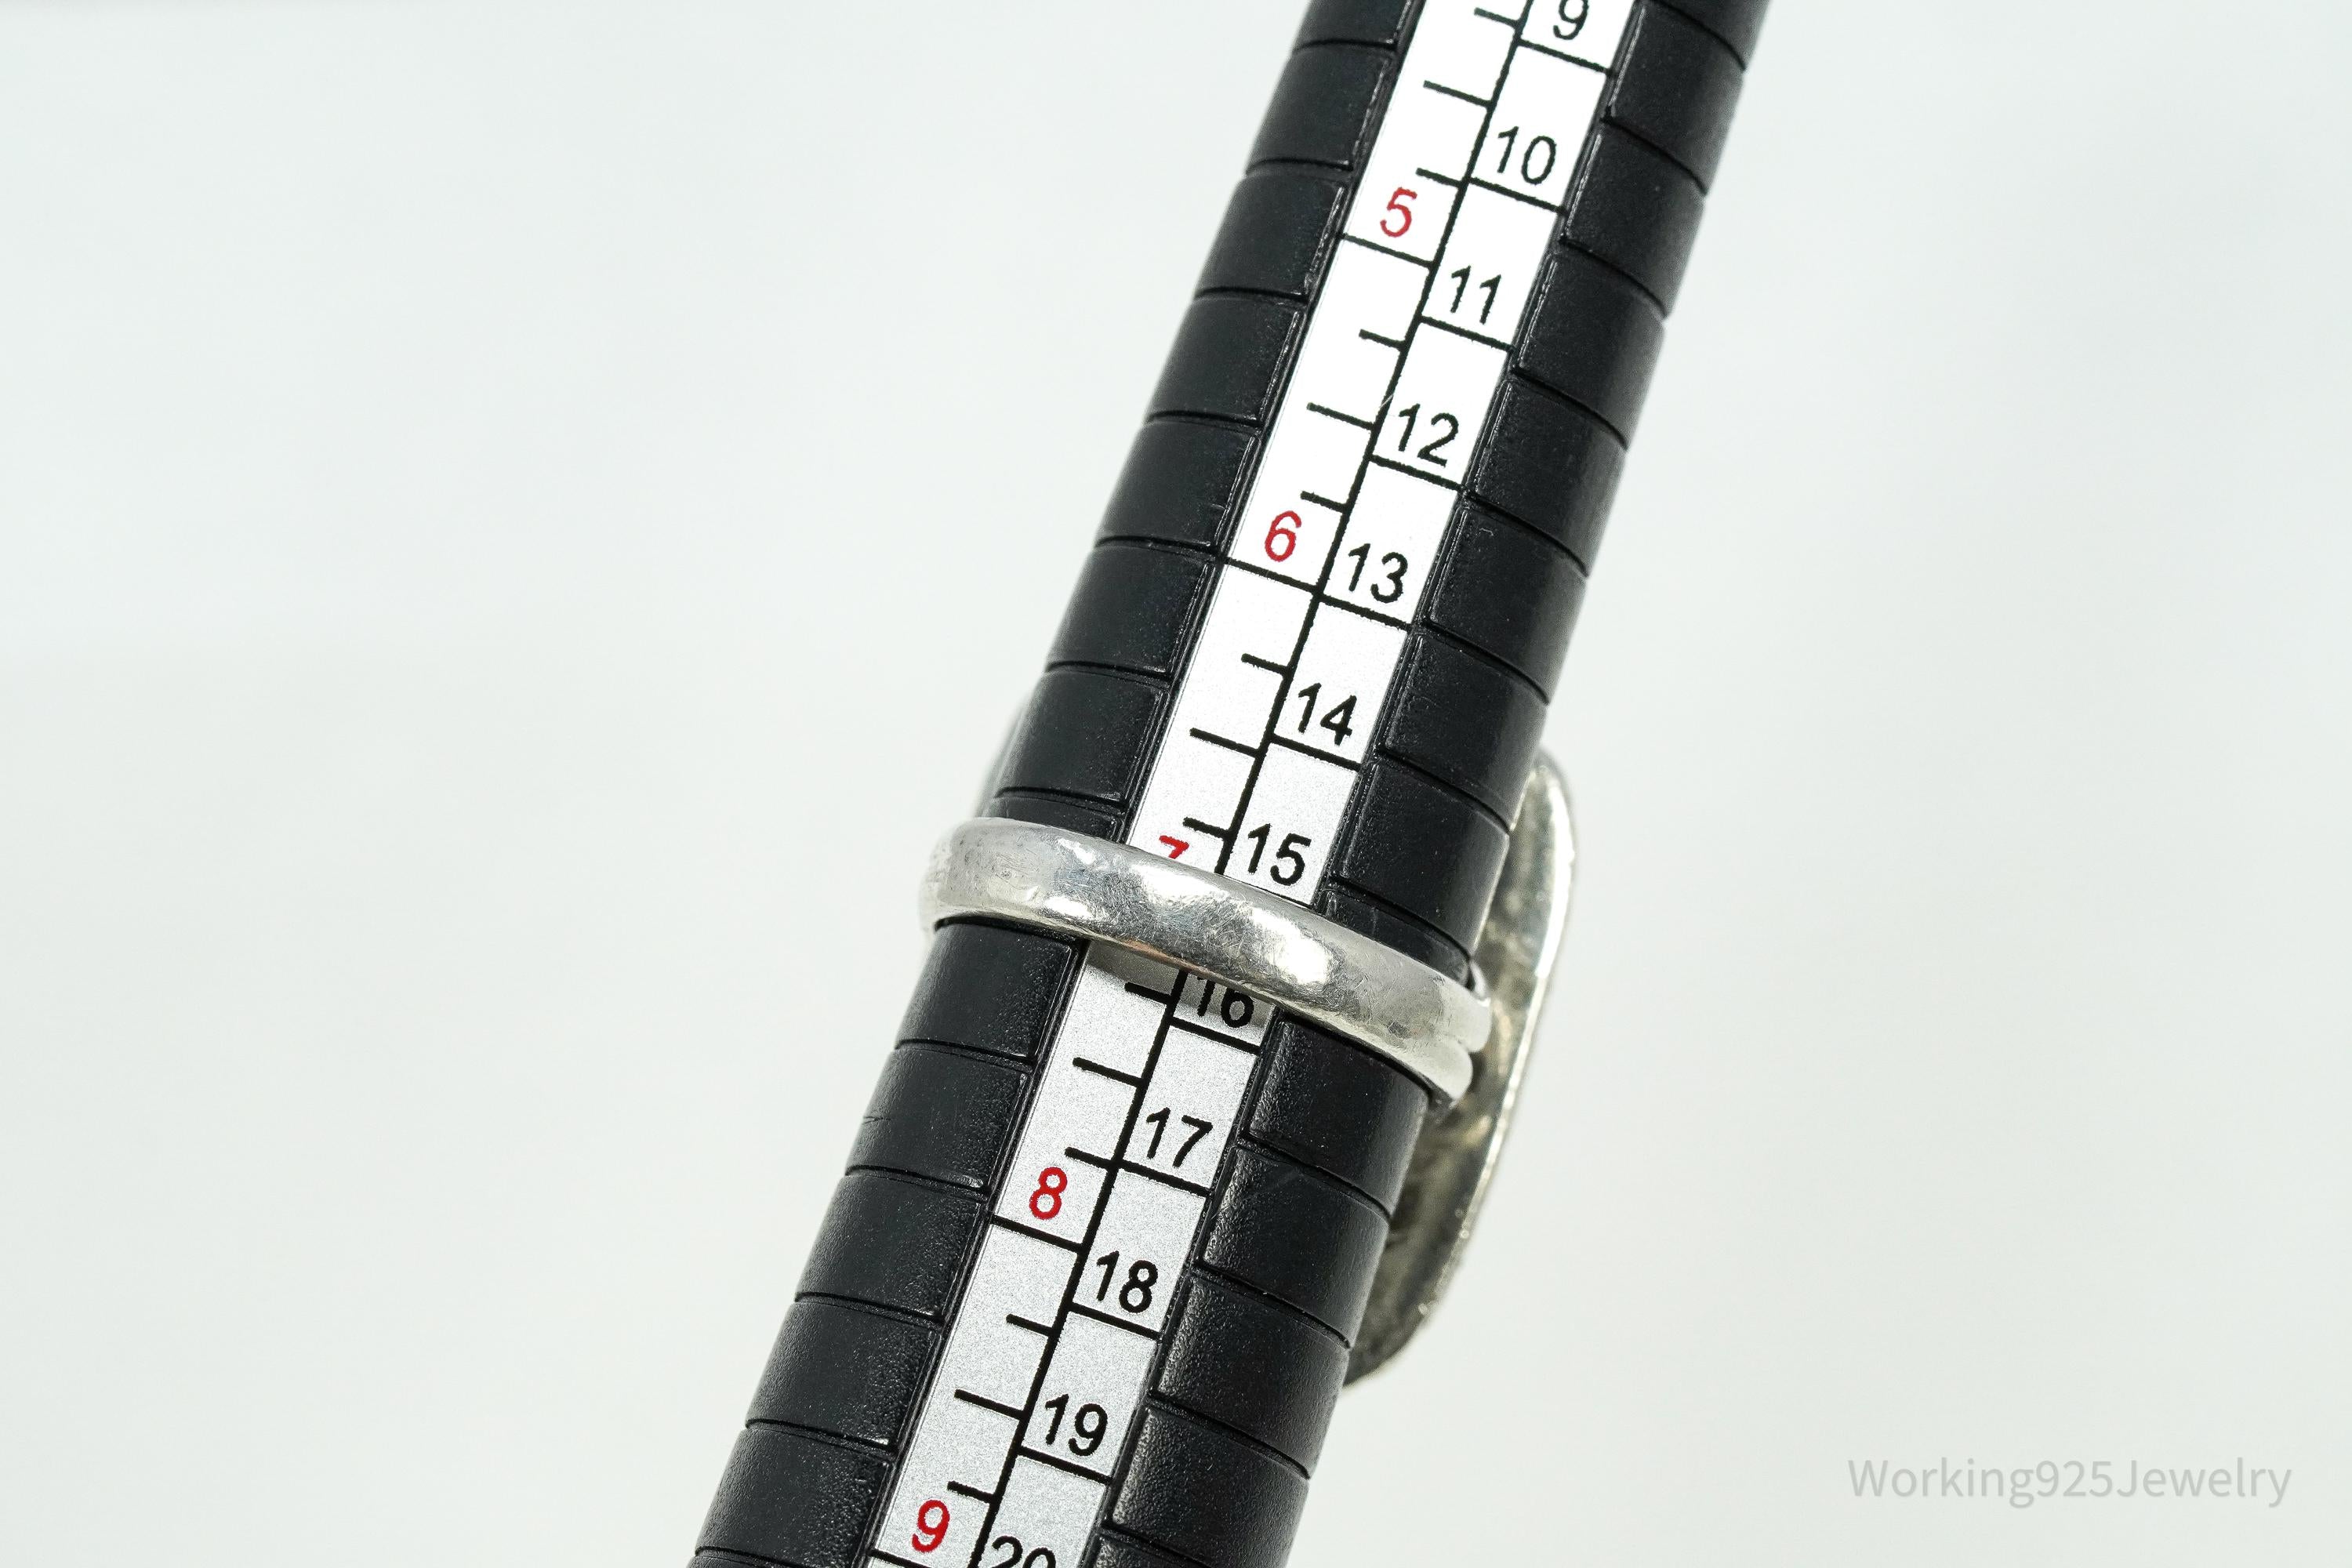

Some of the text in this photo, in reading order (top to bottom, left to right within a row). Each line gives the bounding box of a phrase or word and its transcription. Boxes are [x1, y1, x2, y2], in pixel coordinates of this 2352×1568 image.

[1554, 0, 1589, 40] 9
[1497, 126, 1557, 186] 10
[1380, 187, 1417, 238] 5
[1450, 265, 1502, 325] 11
[1398, 403, 1459, 467] 12
[1265, 510, 1302, 562] 6
[1348, 543, 1408, 604] 13
[1298, 682, 1357, 746] 14
[1247, 822, 1312, 887] 15
[1196, 976, 1254, 1029] 16
[1145, 1106, 1214, 1170] 17
[1029, 1166, 1068, 1221] 8
[1096, 1250, 1159, 1314] 18
[1044, 1393, 1109, 1457] 19
[911, 1499, 950, 1553] 9
